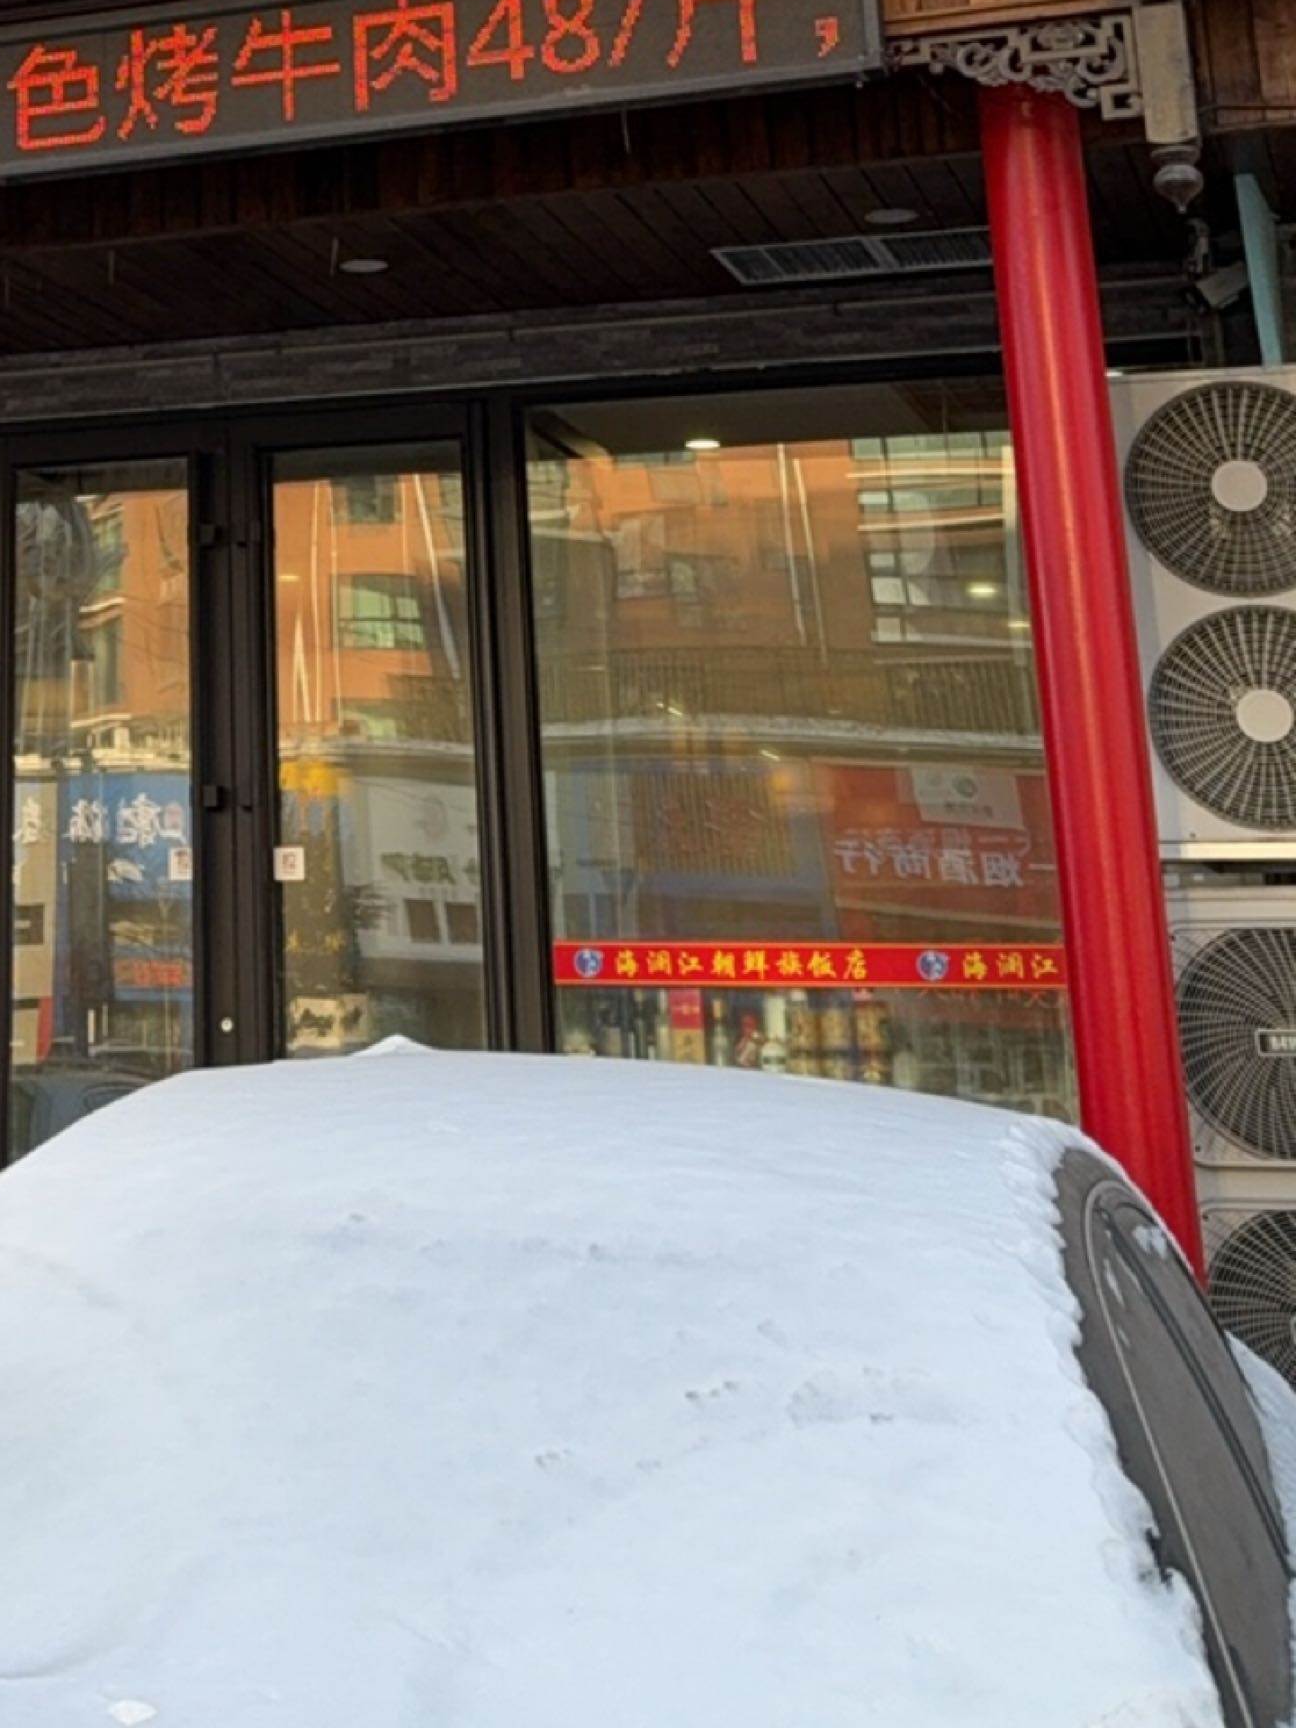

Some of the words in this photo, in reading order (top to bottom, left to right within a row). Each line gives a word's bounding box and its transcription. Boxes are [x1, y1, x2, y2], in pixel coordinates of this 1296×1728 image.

[615, 947, 867, 980] 海澜江朝鲜族饭店
